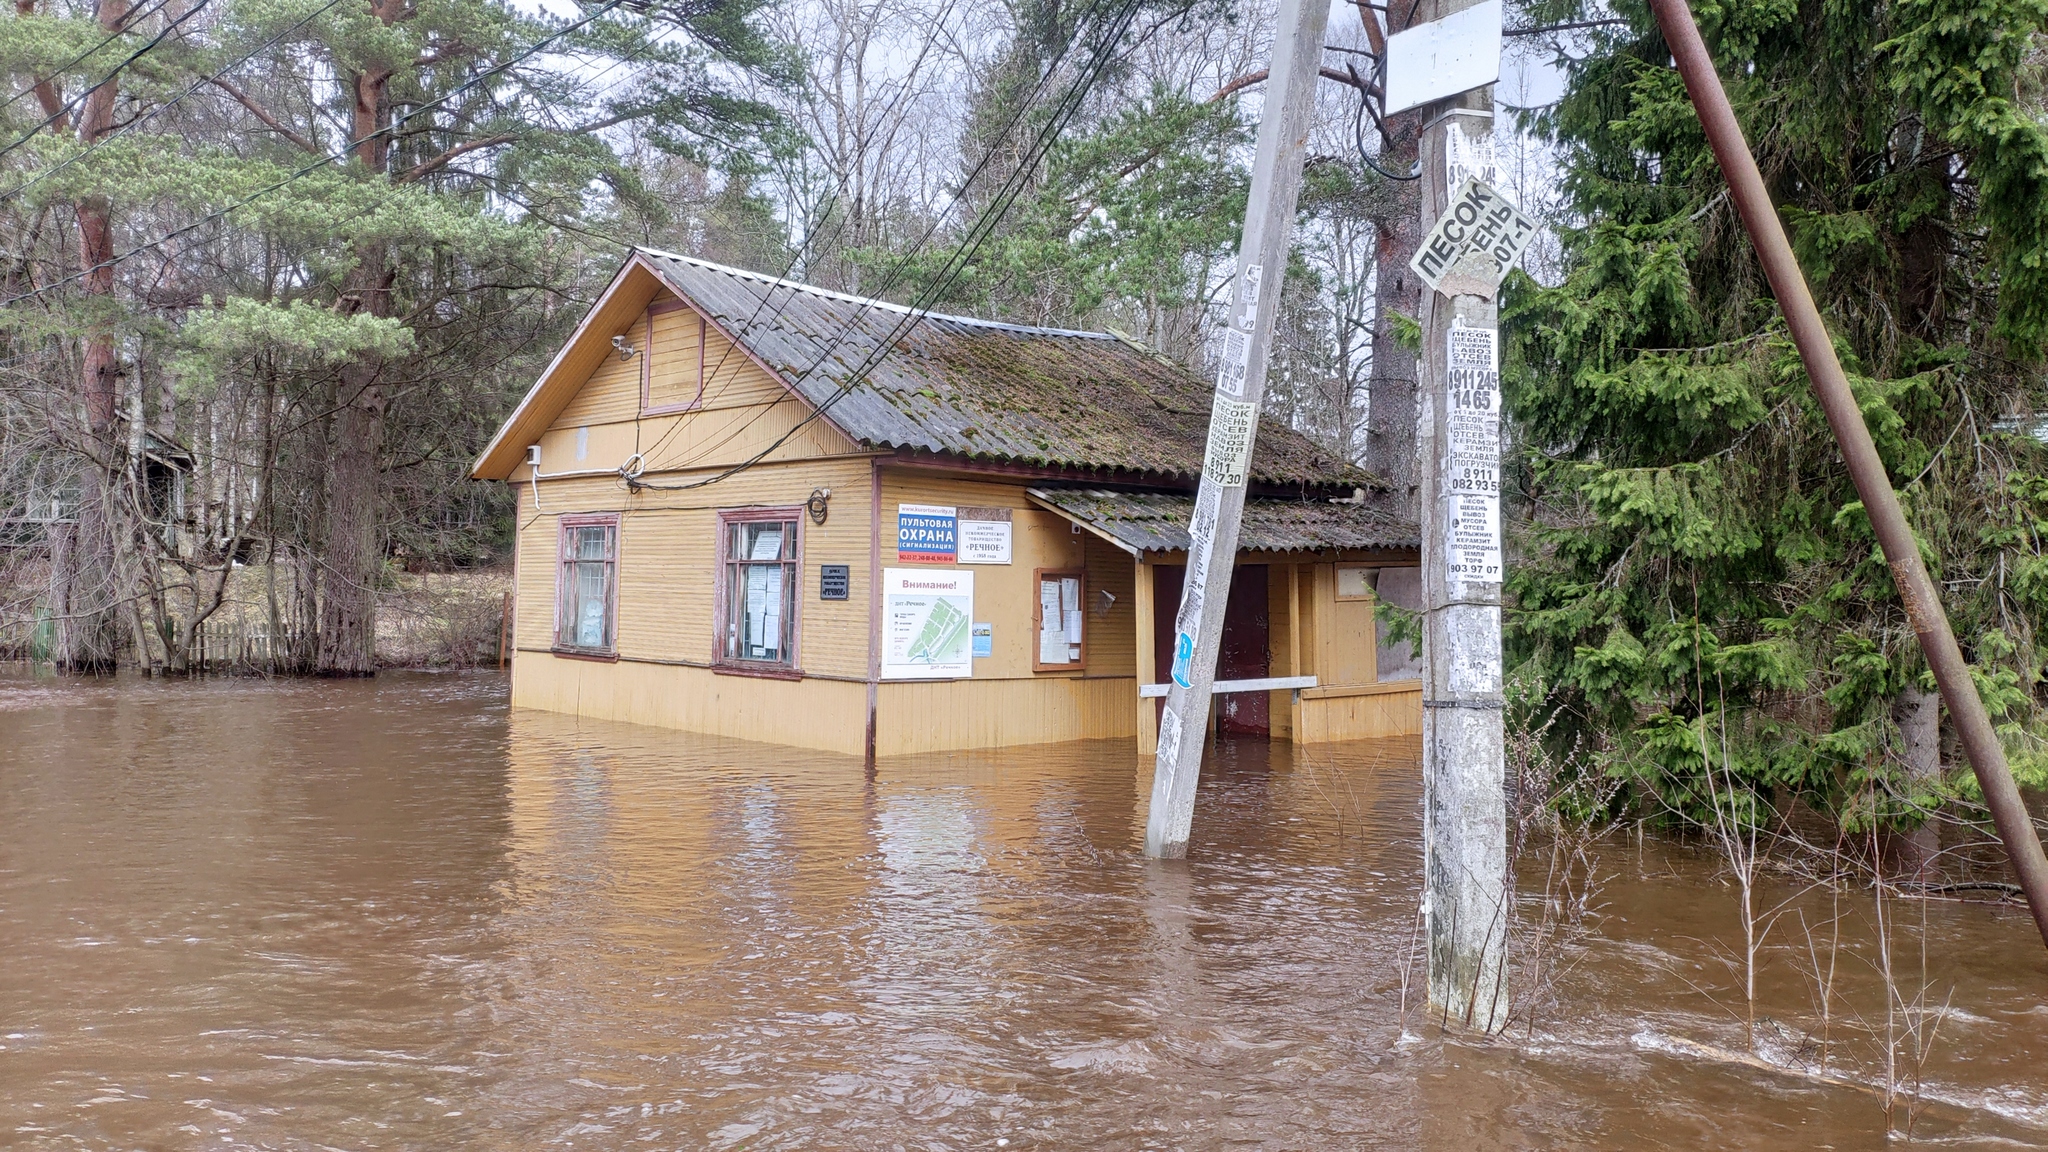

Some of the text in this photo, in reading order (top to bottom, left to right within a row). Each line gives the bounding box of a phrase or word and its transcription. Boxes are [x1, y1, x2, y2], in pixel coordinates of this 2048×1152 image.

[1417, 183, 1493, 279] ПЕСОК
[1452, 206, 1512, 266] ЕНЬ
[1476, 370, 1498, 391] 245
[1216, 402, 1249, 417] ПЕСОК
[1214, 410, 1248, 426] ЩЕБЕНЬ
[1453, 415, 1484, 424] ПЕСОК
[1213, 418, 1248, 434] ОТСЕВ
[1453, 423, 1484, 432] ЩЕБЕНЬ
[1211, 432, 1244, 446] НАВОЗ
[1453, 431, 1485, 439] ОТСЕВ
[1210, 438, 1244, 452] ЗЕМЛЯ
[1453, 438, 1499, 446] КЕРАМЗИ
[1453, 452, 1498, 462] ЭКСКАВАТО
[1227, 474, 1241, 484] 30
[1453, 478, 1473, 490] 082
[901, 517, 953, 529] ПУЛЬТОВАЯ
[899, 528, 954, 543] ОХРАНА
[899, 541, 954, 550] (СИГНАЛИЗАЦИЯ)
[1450, 564, 1499, 574] 903 97 07
[902, 580, 957, 590] Внимание!
